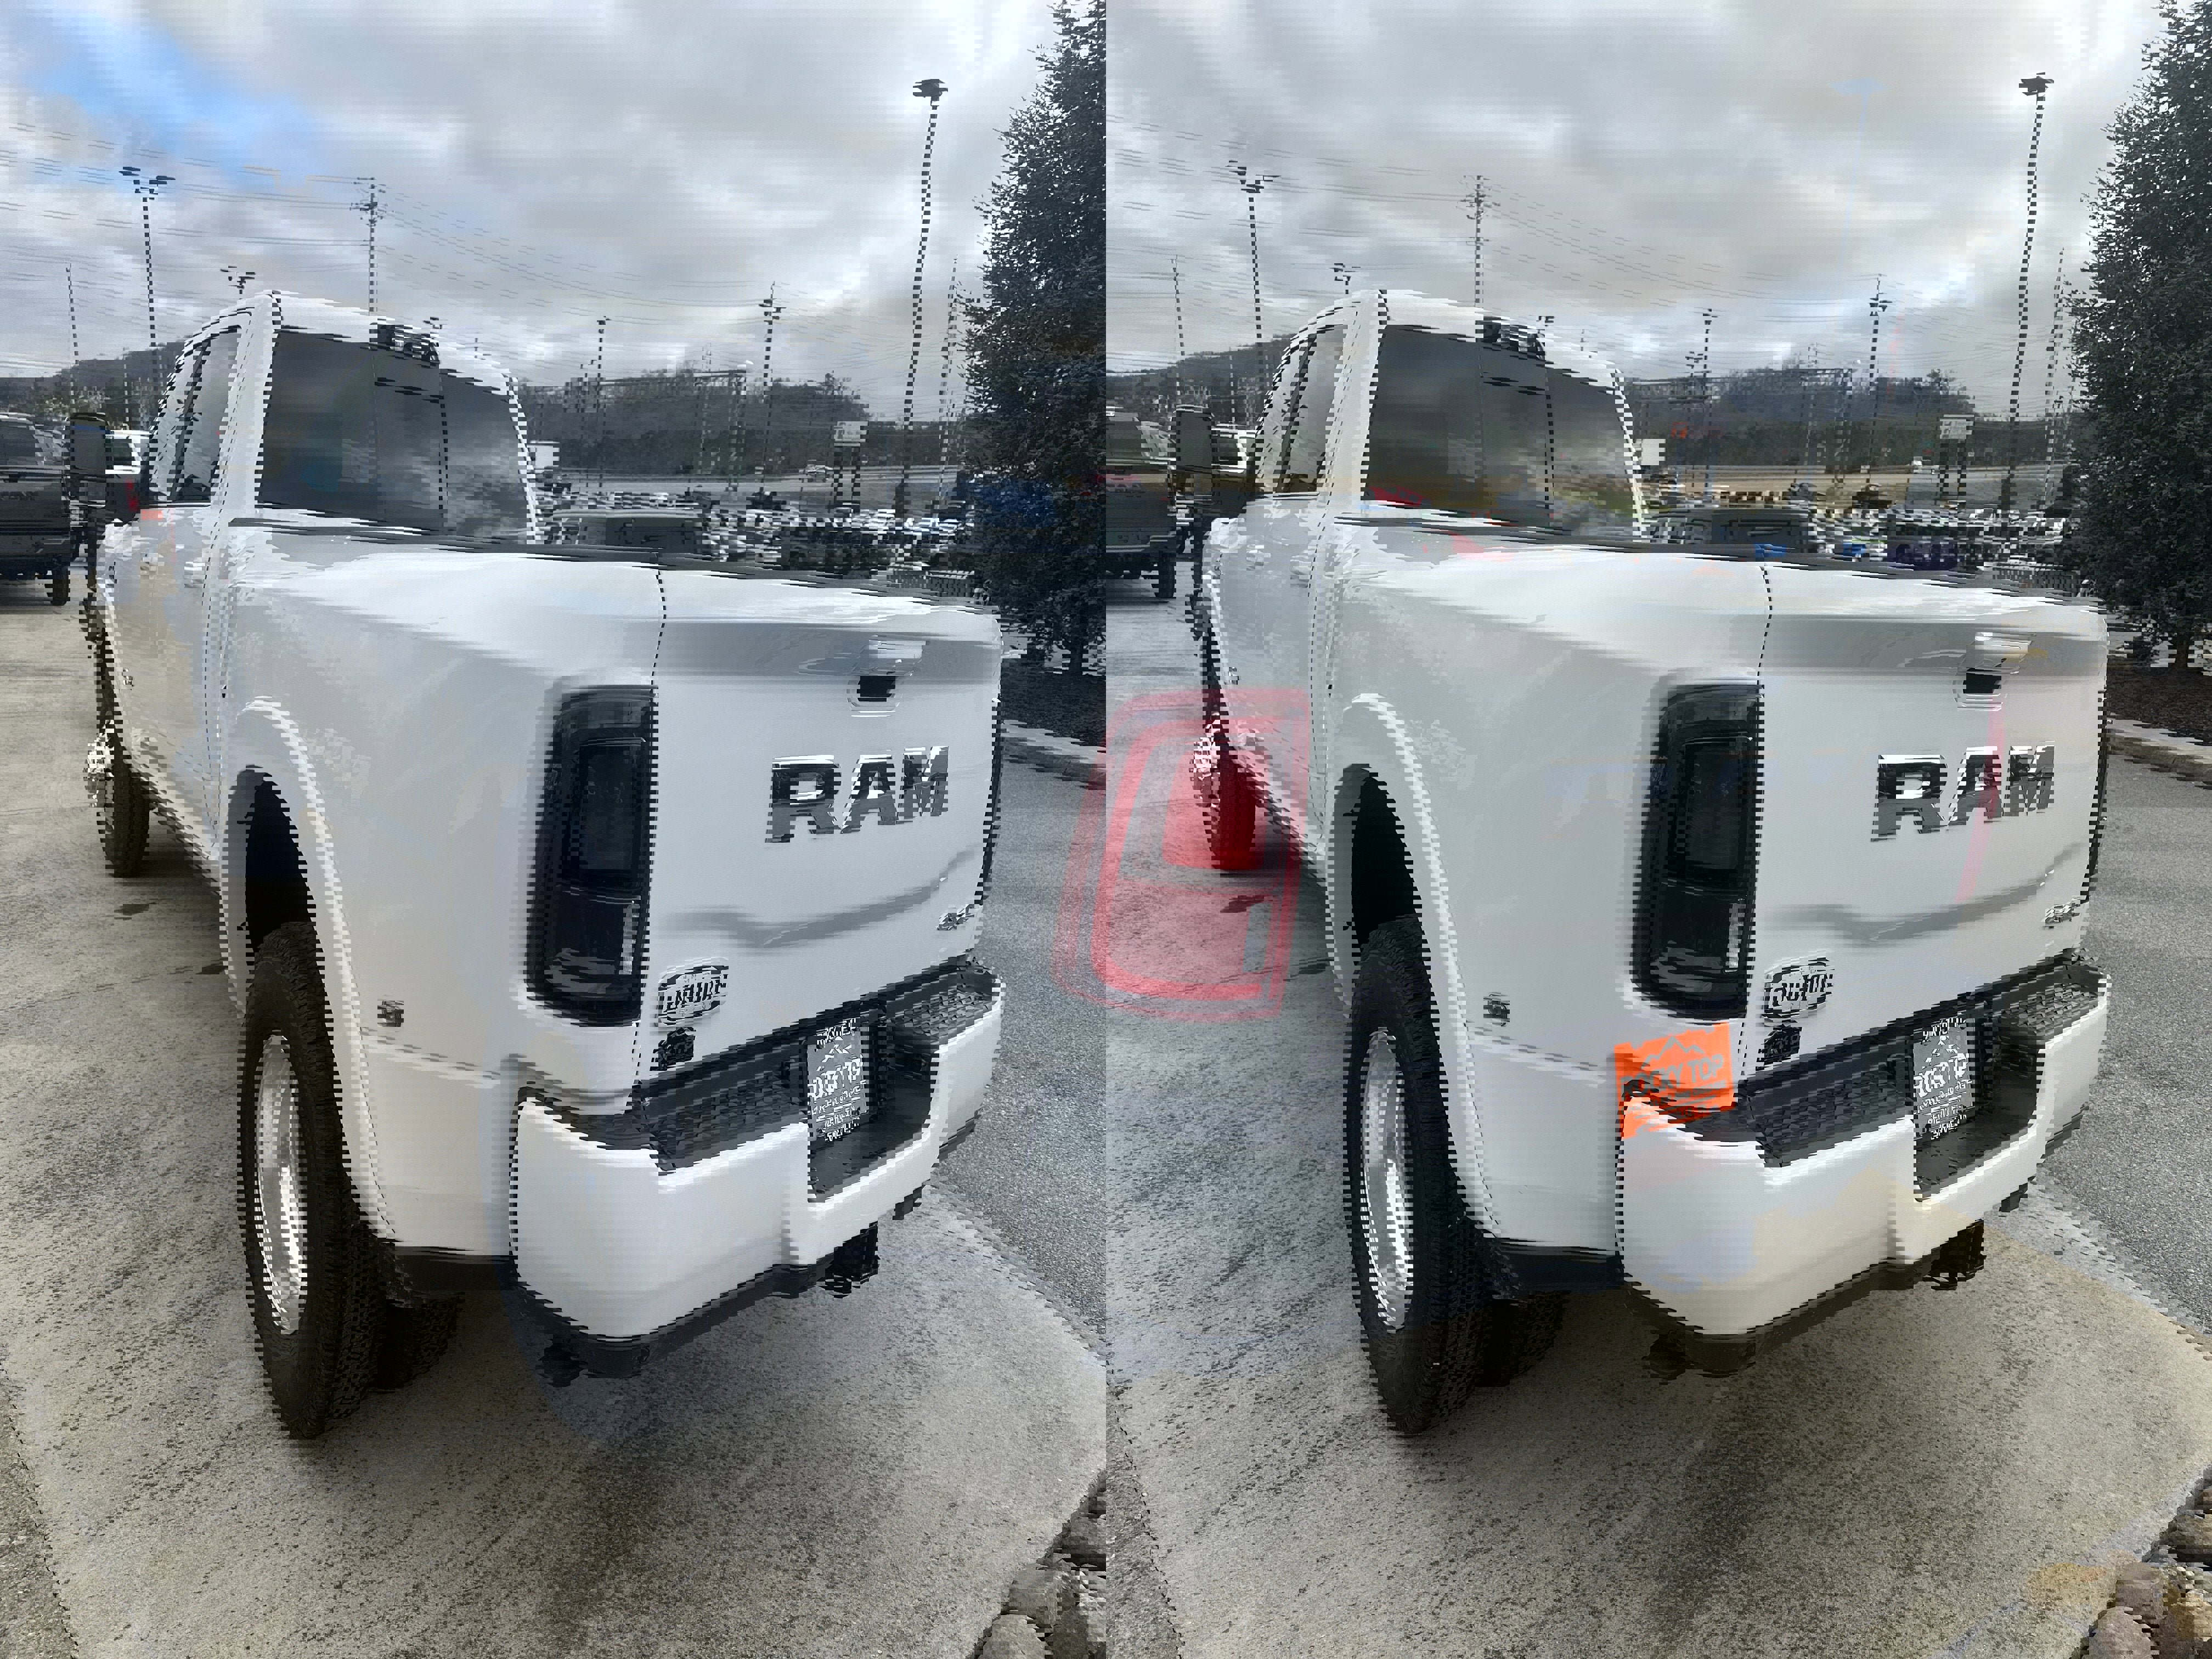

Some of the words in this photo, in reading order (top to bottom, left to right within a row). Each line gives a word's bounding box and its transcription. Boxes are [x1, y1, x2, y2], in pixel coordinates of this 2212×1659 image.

[765, 746, 949, 843] RAM
[1870, 741, 2055, 842] RAM
[1688, 1054, 1724, 1084] TOP
